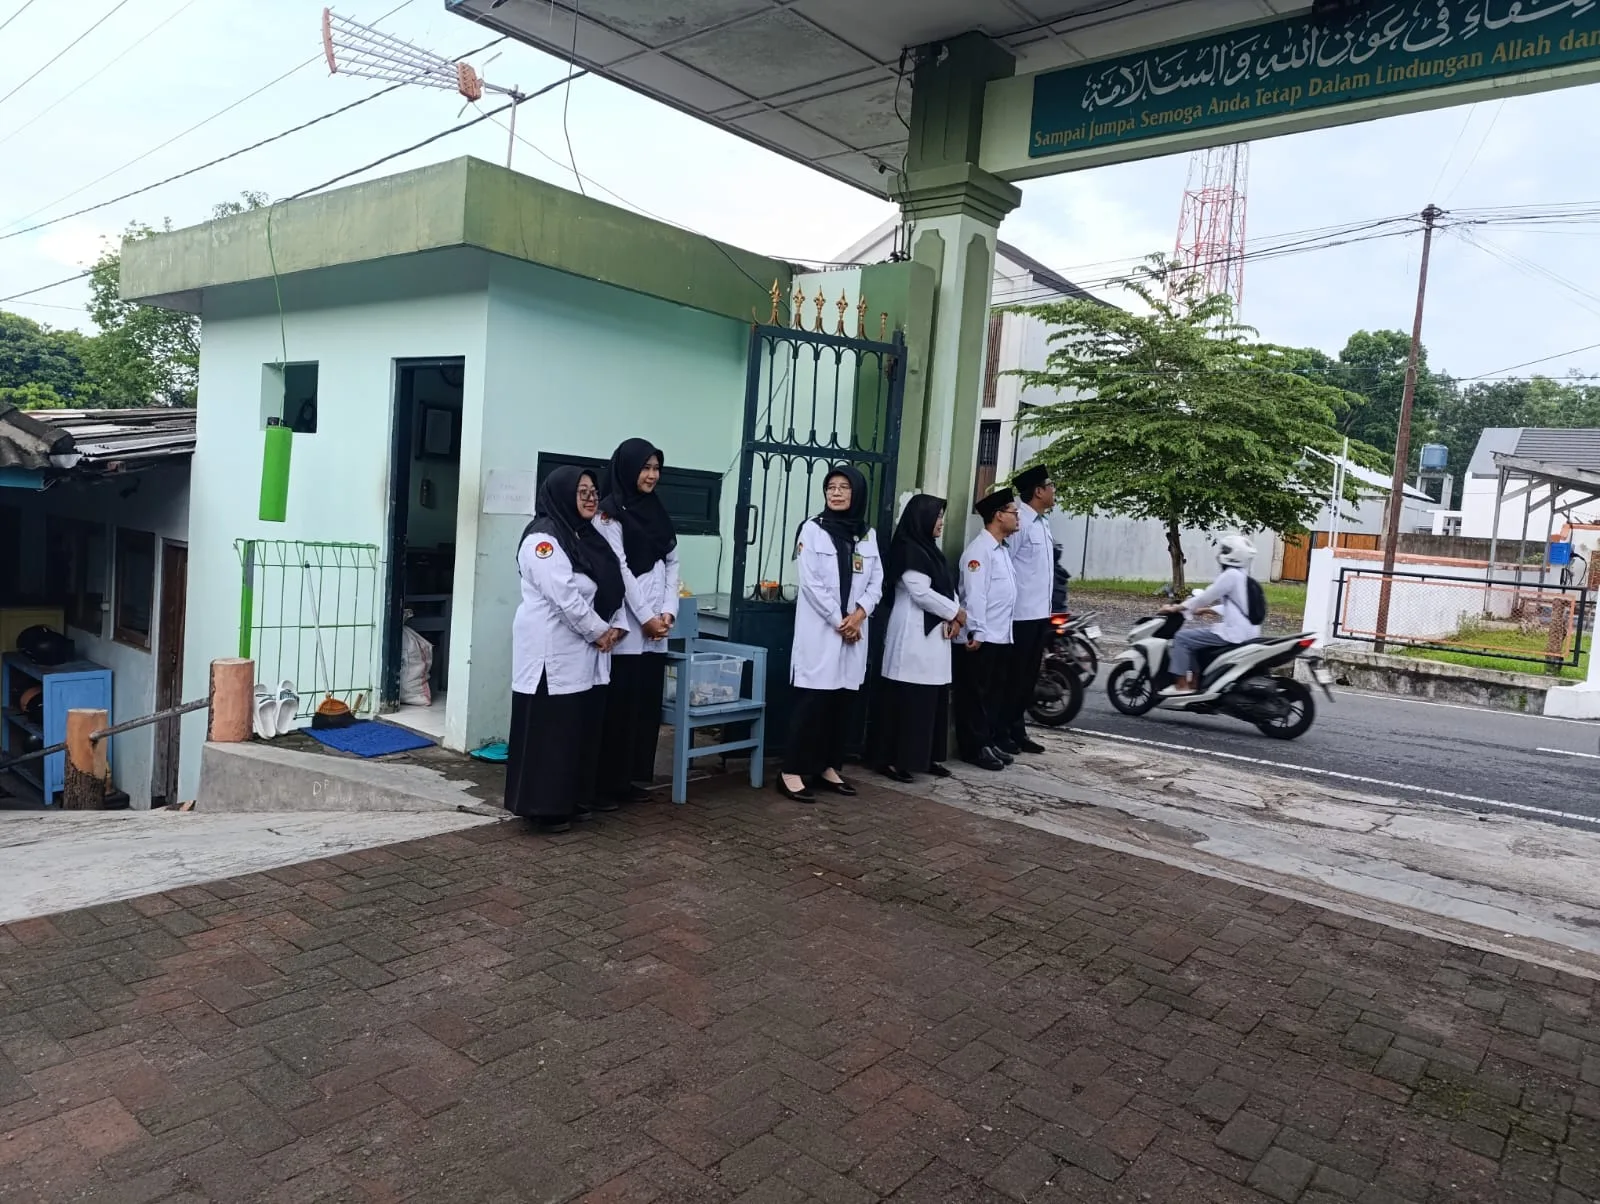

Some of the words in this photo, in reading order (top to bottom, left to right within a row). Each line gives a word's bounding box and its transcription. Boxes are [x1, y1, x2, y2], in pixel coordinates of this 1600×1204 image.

[1034, 122, 1085, 148] Sampai
[1089, 118, 1135, 141] Jumpa
[1140, 106, 1203, 128] Semoga
[1207, 94, 1250, 115] Anda
[1256, 85, 1302, 107] Tetap
[1309, 73, 1370, 97] Dalam
[1376, 51, 1483, 84] Lindungan
[1491, 35, 1551, 64] Allah
[1559, 29, 1600, 51] dan
